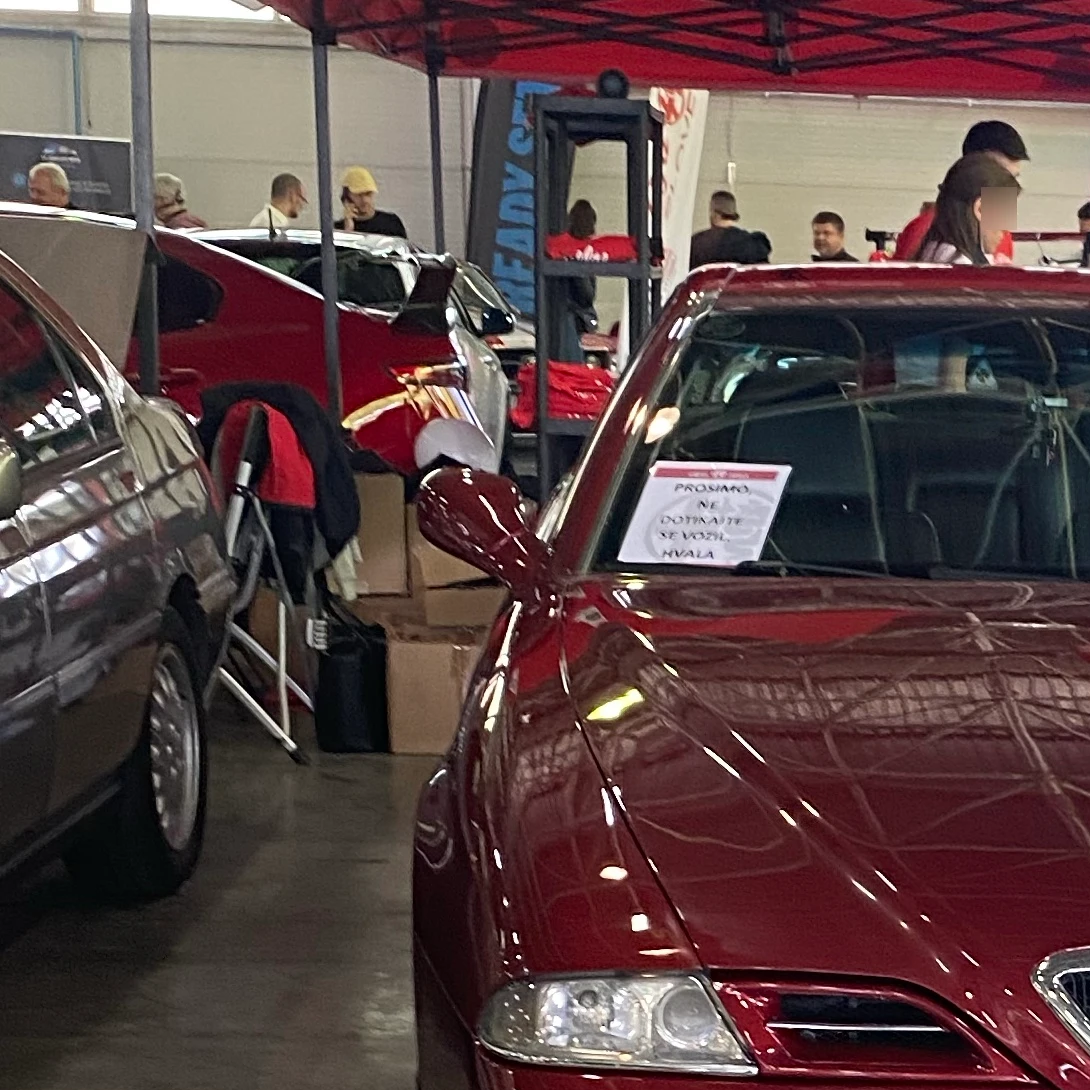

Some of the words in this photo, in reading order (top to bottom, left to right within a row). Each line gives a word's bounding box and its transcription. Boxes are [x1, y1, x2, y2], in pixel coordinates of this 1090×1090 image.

[698, 500, 718, 510] NE
[659, 531, 677, 540] SE
[662, 549, 714, 560] HVALA
